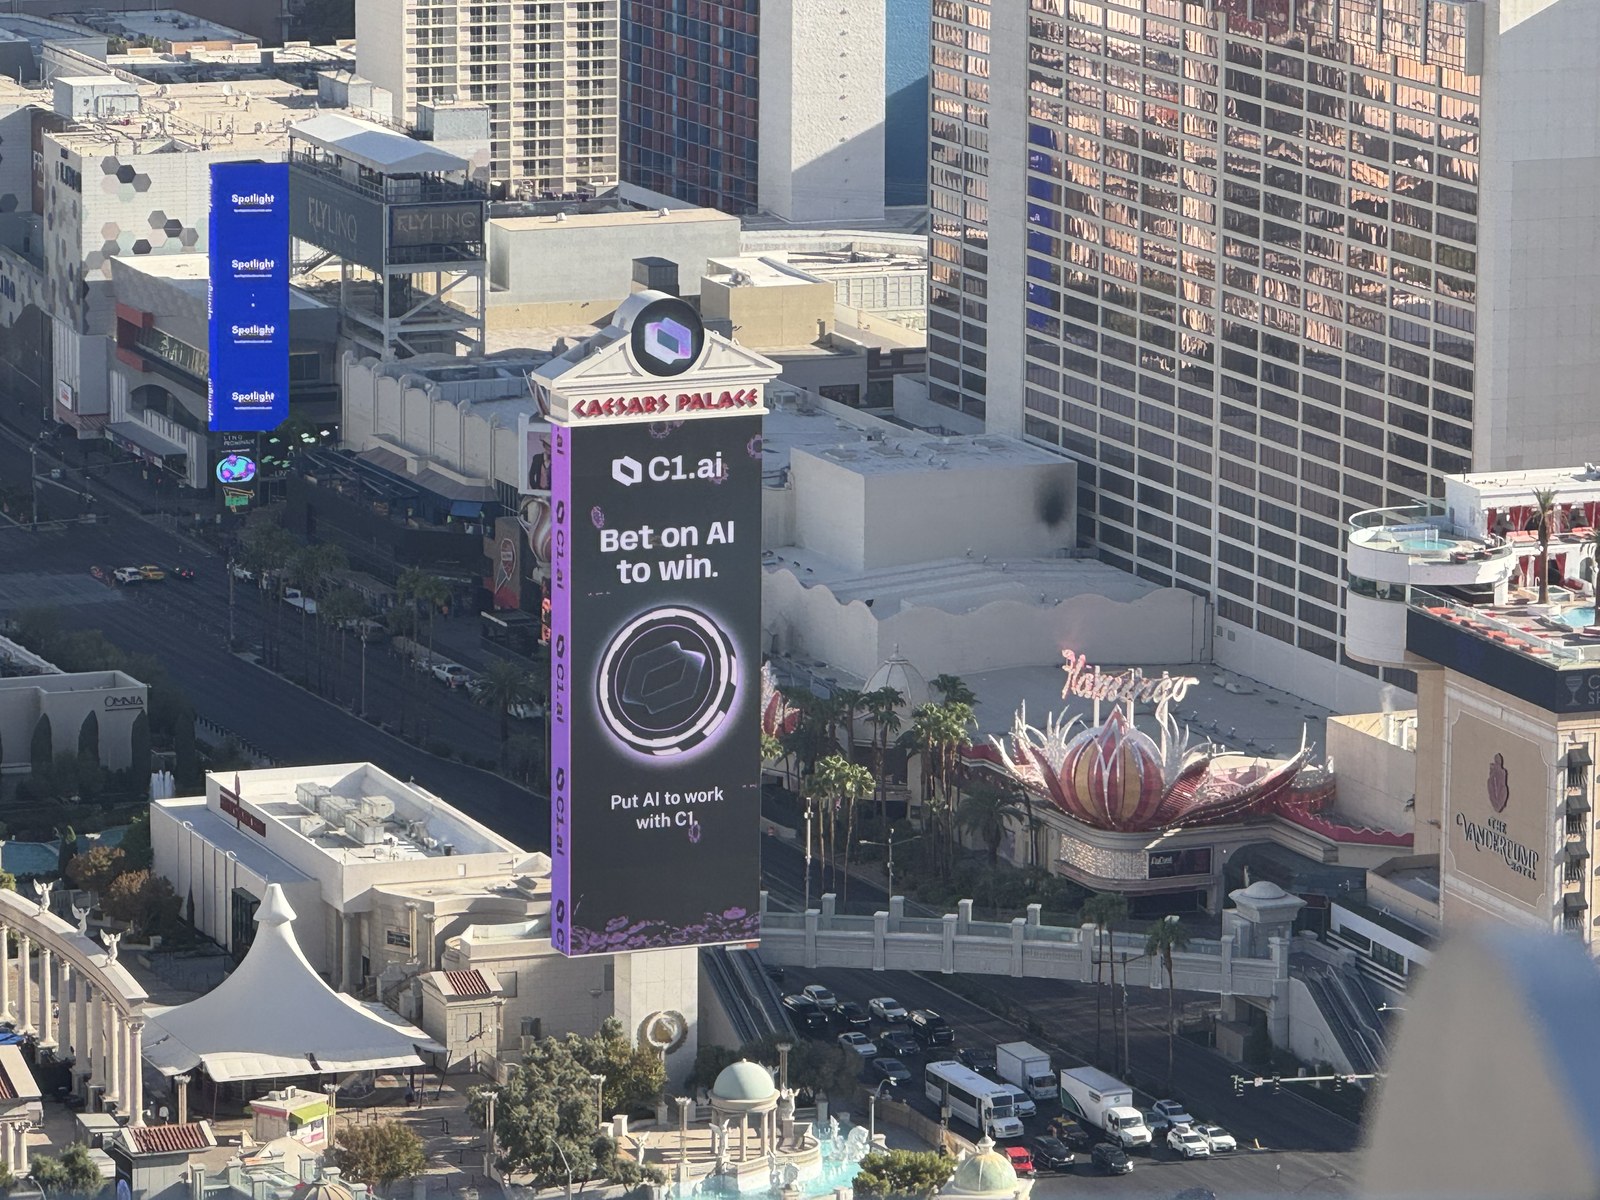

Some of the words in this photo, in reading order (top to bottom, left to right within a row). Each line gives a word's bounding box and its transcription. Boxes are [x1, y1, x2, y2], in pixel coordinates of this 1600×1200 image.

[231, 193, 275, 205] Spotlight
[397, 211, 477, 233] FLYLINQ
[231, 259, 275, 270] Spotlight
[231, 325, 275, 336] Spotlight
[231, 391, 275, 403] Spotlight
[571, 394, 670, 419] CAESARS
[675, 388, 758, 412] PALACE
[648, 451, 722, 482] C1.ai
[600, 525, 654, 553] Bet
[661, 526, 699, 548] on
[706, 521, 735, 545] AI
[616, 560, 651, 584] to
[658, 553, 719, 581] win.
[104, 695, 144, 707] OMNIA
[611, 795, 639, 810] Put
[642, 791, 660, 808] AI
[664, 791, 681, 806] to
[684, 786, 724, 804] work
[636, 813, 671, 830] with
[675, 811, 698, 827] C1.
[1456, 812, 1539, 871] VANDERPUMP
